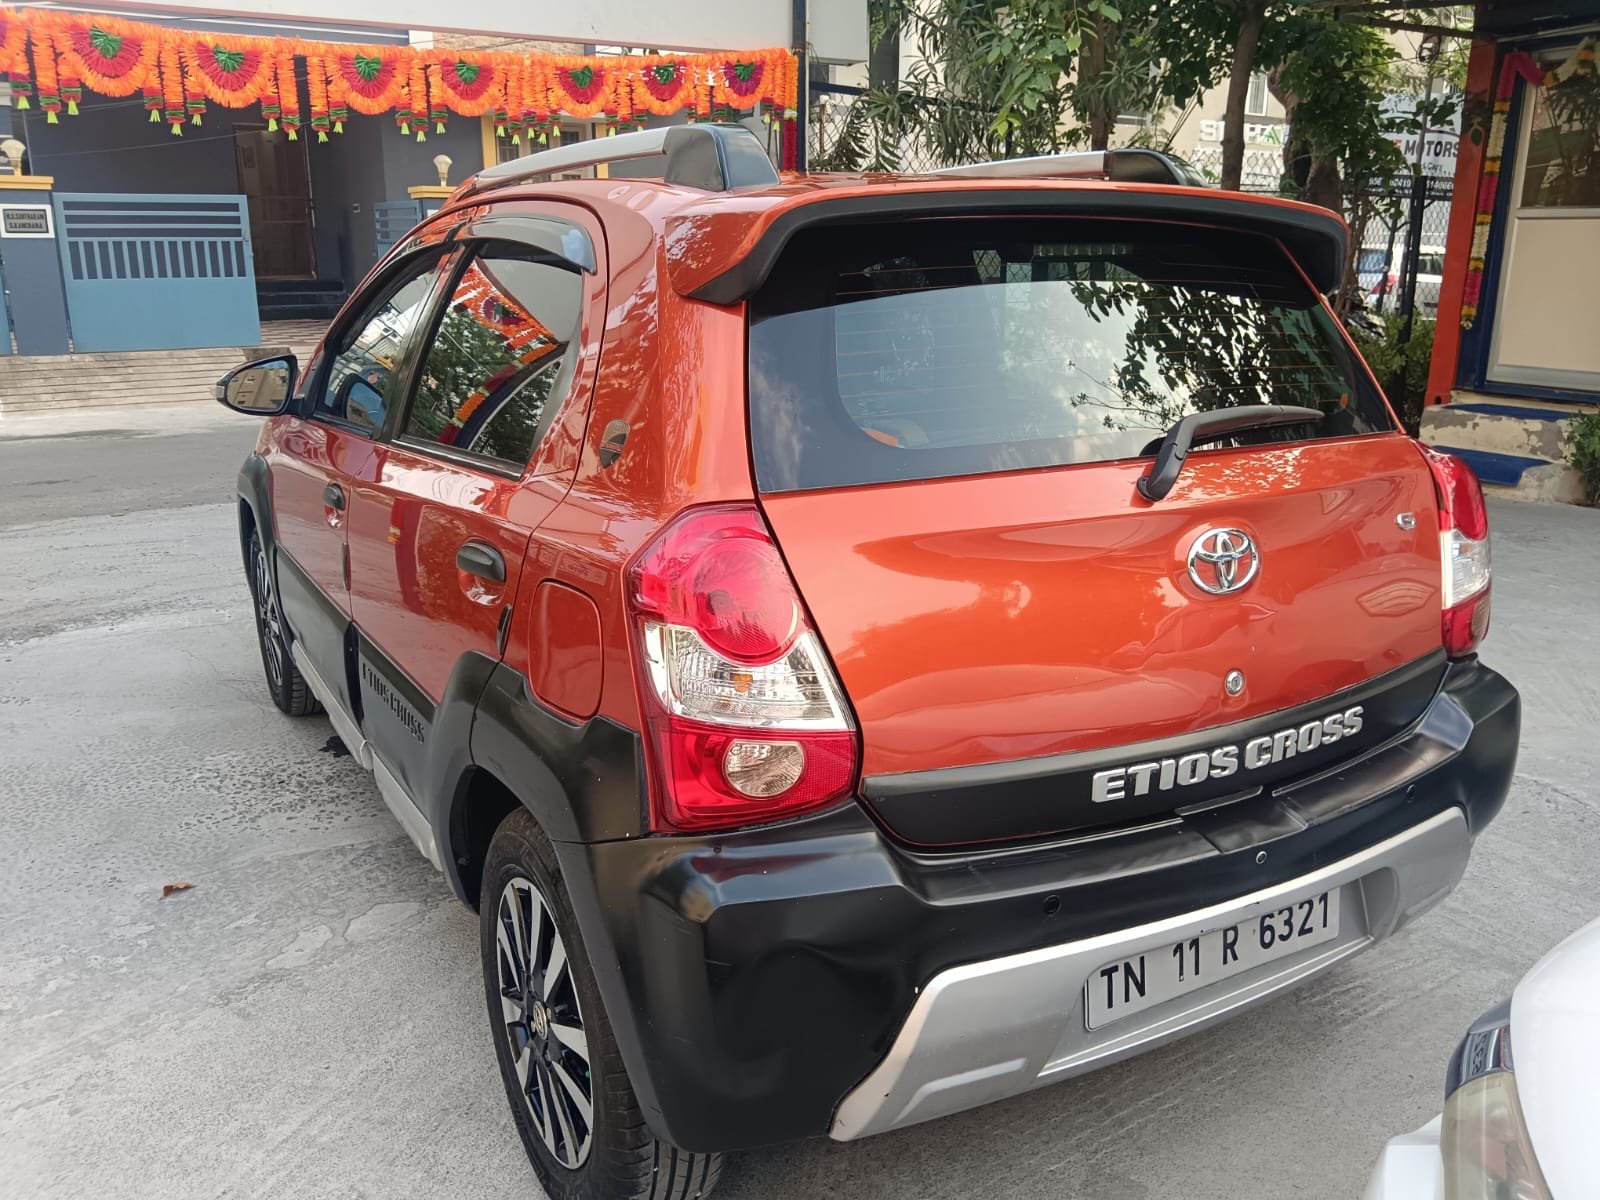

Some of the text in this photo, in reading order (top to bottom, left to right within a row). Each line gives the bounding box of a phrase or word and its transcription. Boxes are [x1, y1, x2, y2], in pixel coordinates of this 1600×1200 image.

[1404, 139, 1459, 158] MTORS
[1092, 705, 1364, 803] ETIOS CROSS
[1100, 891, 1330, 1009] TN 11 R 6321
